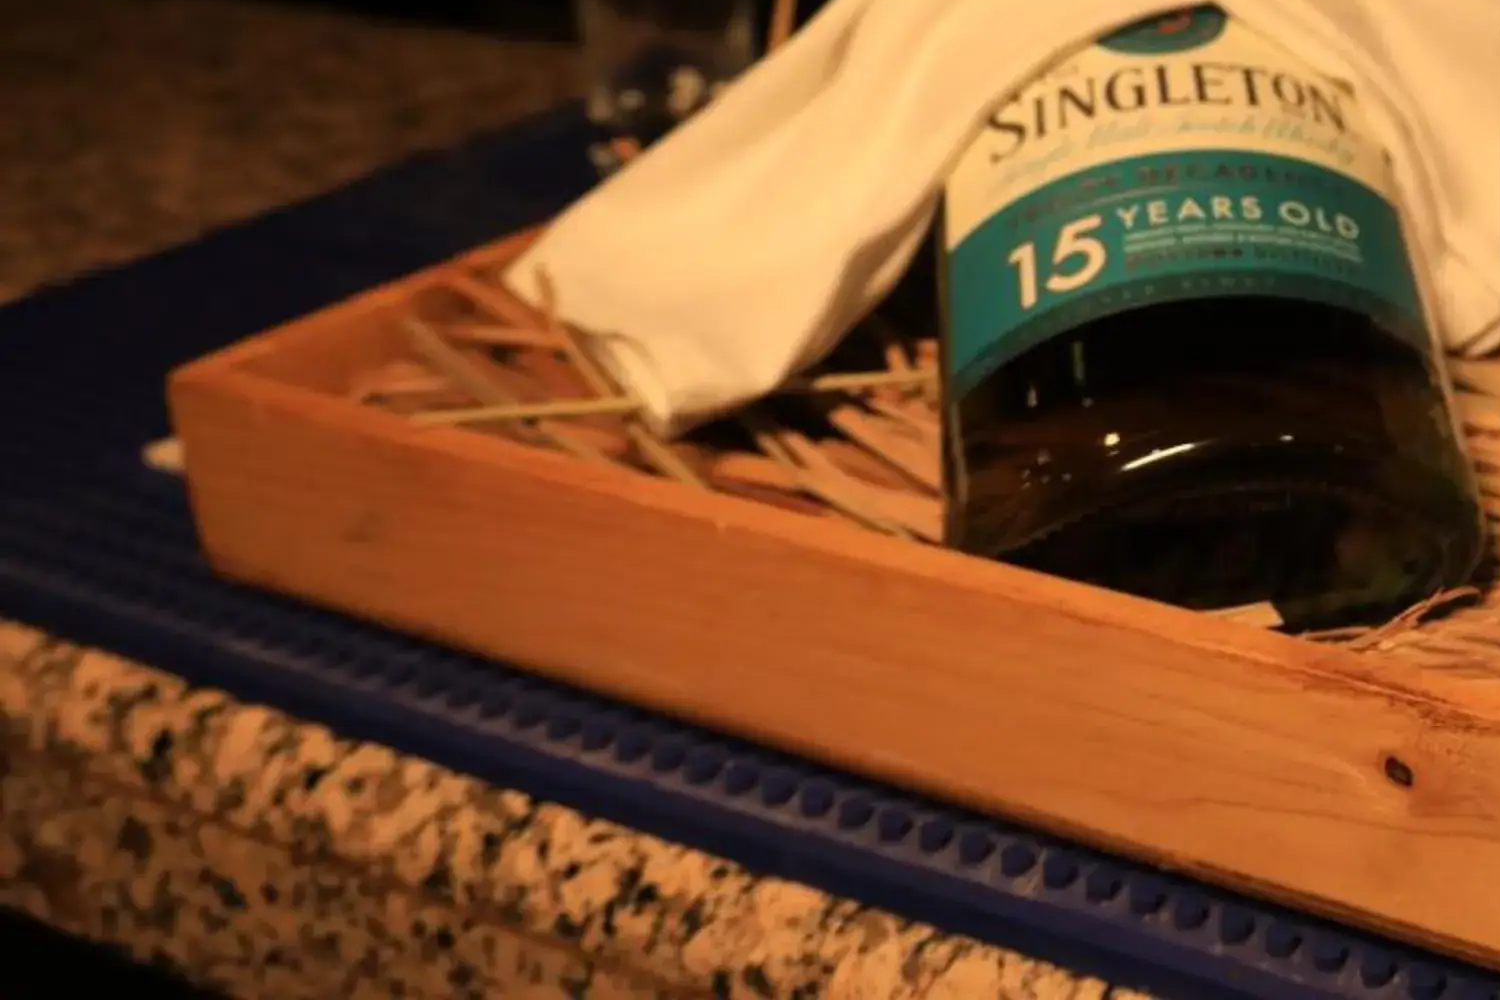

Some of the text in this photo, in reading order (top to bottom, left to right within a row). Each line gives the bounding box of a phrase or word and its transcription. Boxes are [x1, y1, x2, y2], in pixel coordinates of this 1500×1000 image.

[987, 62, 1346, 164] SINGLETON
[1007, 213, 1107, 311] 15
[1116, 195, 1264, 230] YEARS
[1277, 199, 1361, 241] OLD
